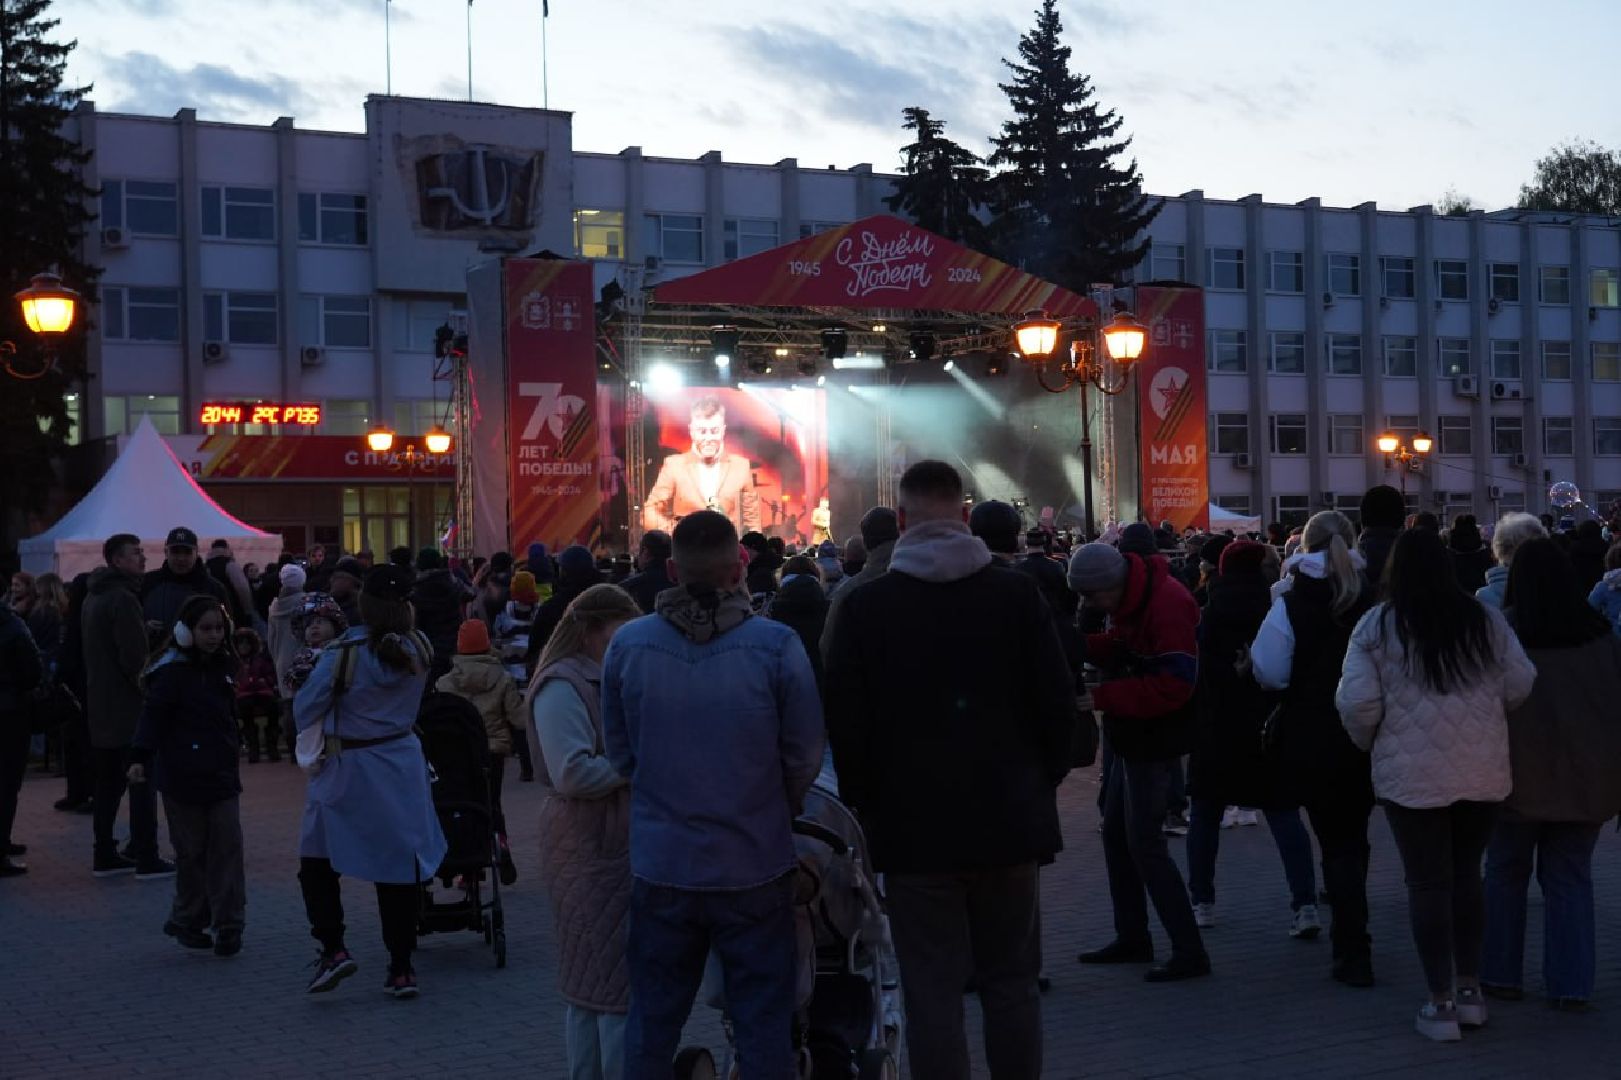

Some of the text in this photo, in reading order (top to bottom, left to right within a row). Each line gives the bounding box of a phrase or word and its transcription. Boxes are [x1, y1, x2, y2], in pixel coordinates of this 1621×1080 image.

[836, 238, 852, 265] С
[788, 260, 822, 277] 1945
[947, 267, 981, 283] 2024
[519, 445, 549, 459] ЛЕТ
[1151, 444, 1198, 465] МАЯ
[519, 462, 592, 476] ПОБЕДЫ!
